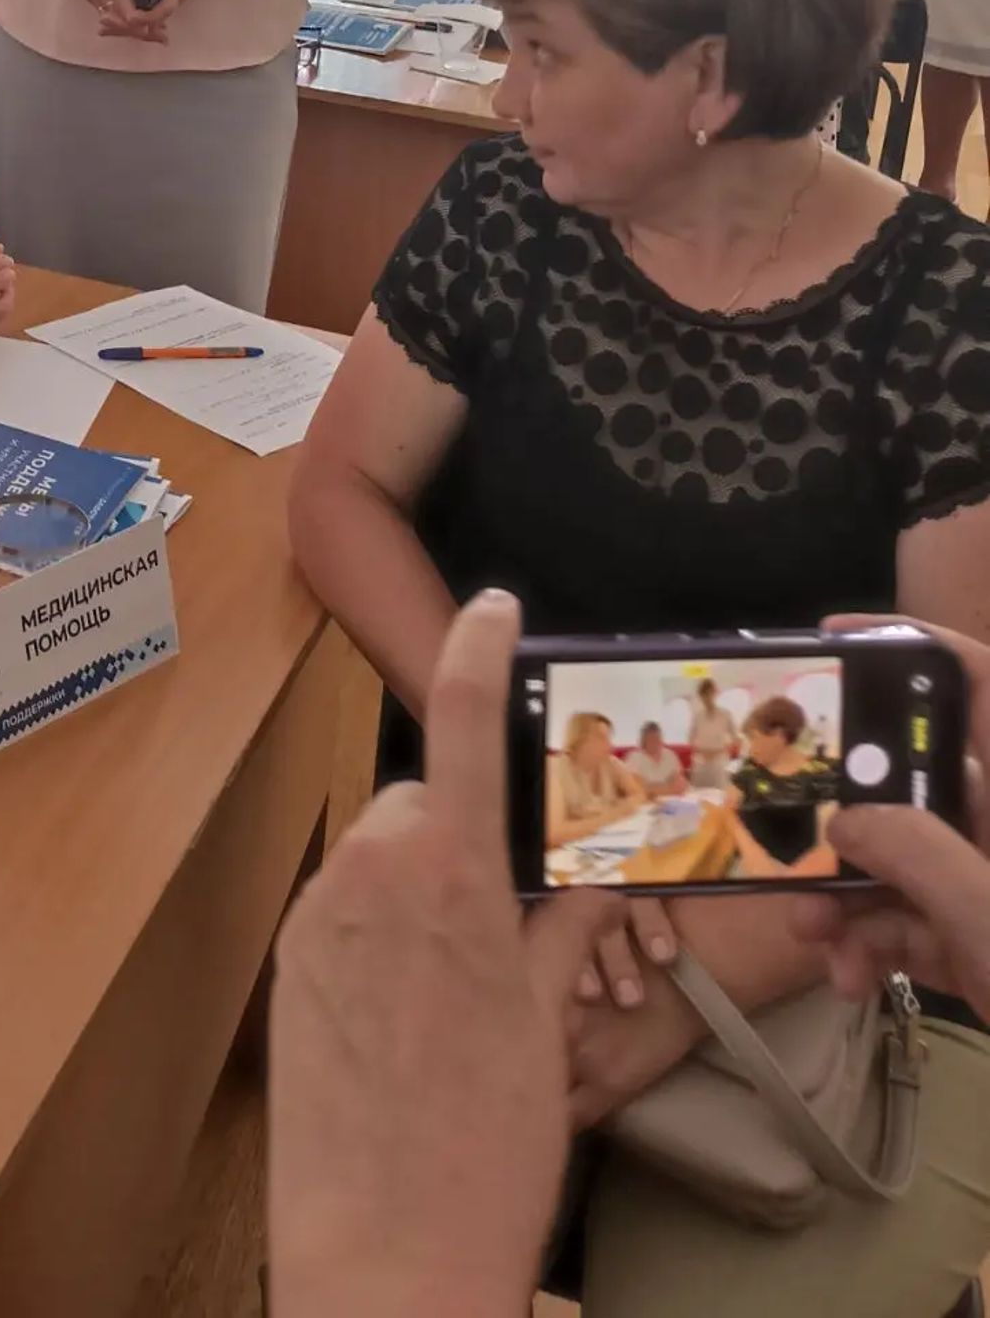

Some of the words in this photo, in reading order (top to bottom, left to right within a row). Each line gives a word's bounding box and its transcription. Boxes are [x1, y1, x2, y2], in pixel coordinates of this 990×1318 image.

[15, 476, 57, 518] МЕЫ
[20, 549, 159, 633] МЕДИЦИНСКАЯ
[24, 605, 111, 661] ПОМОЩЬ
[2, 689, 66, 730] ПОДДЕРЖКИ
